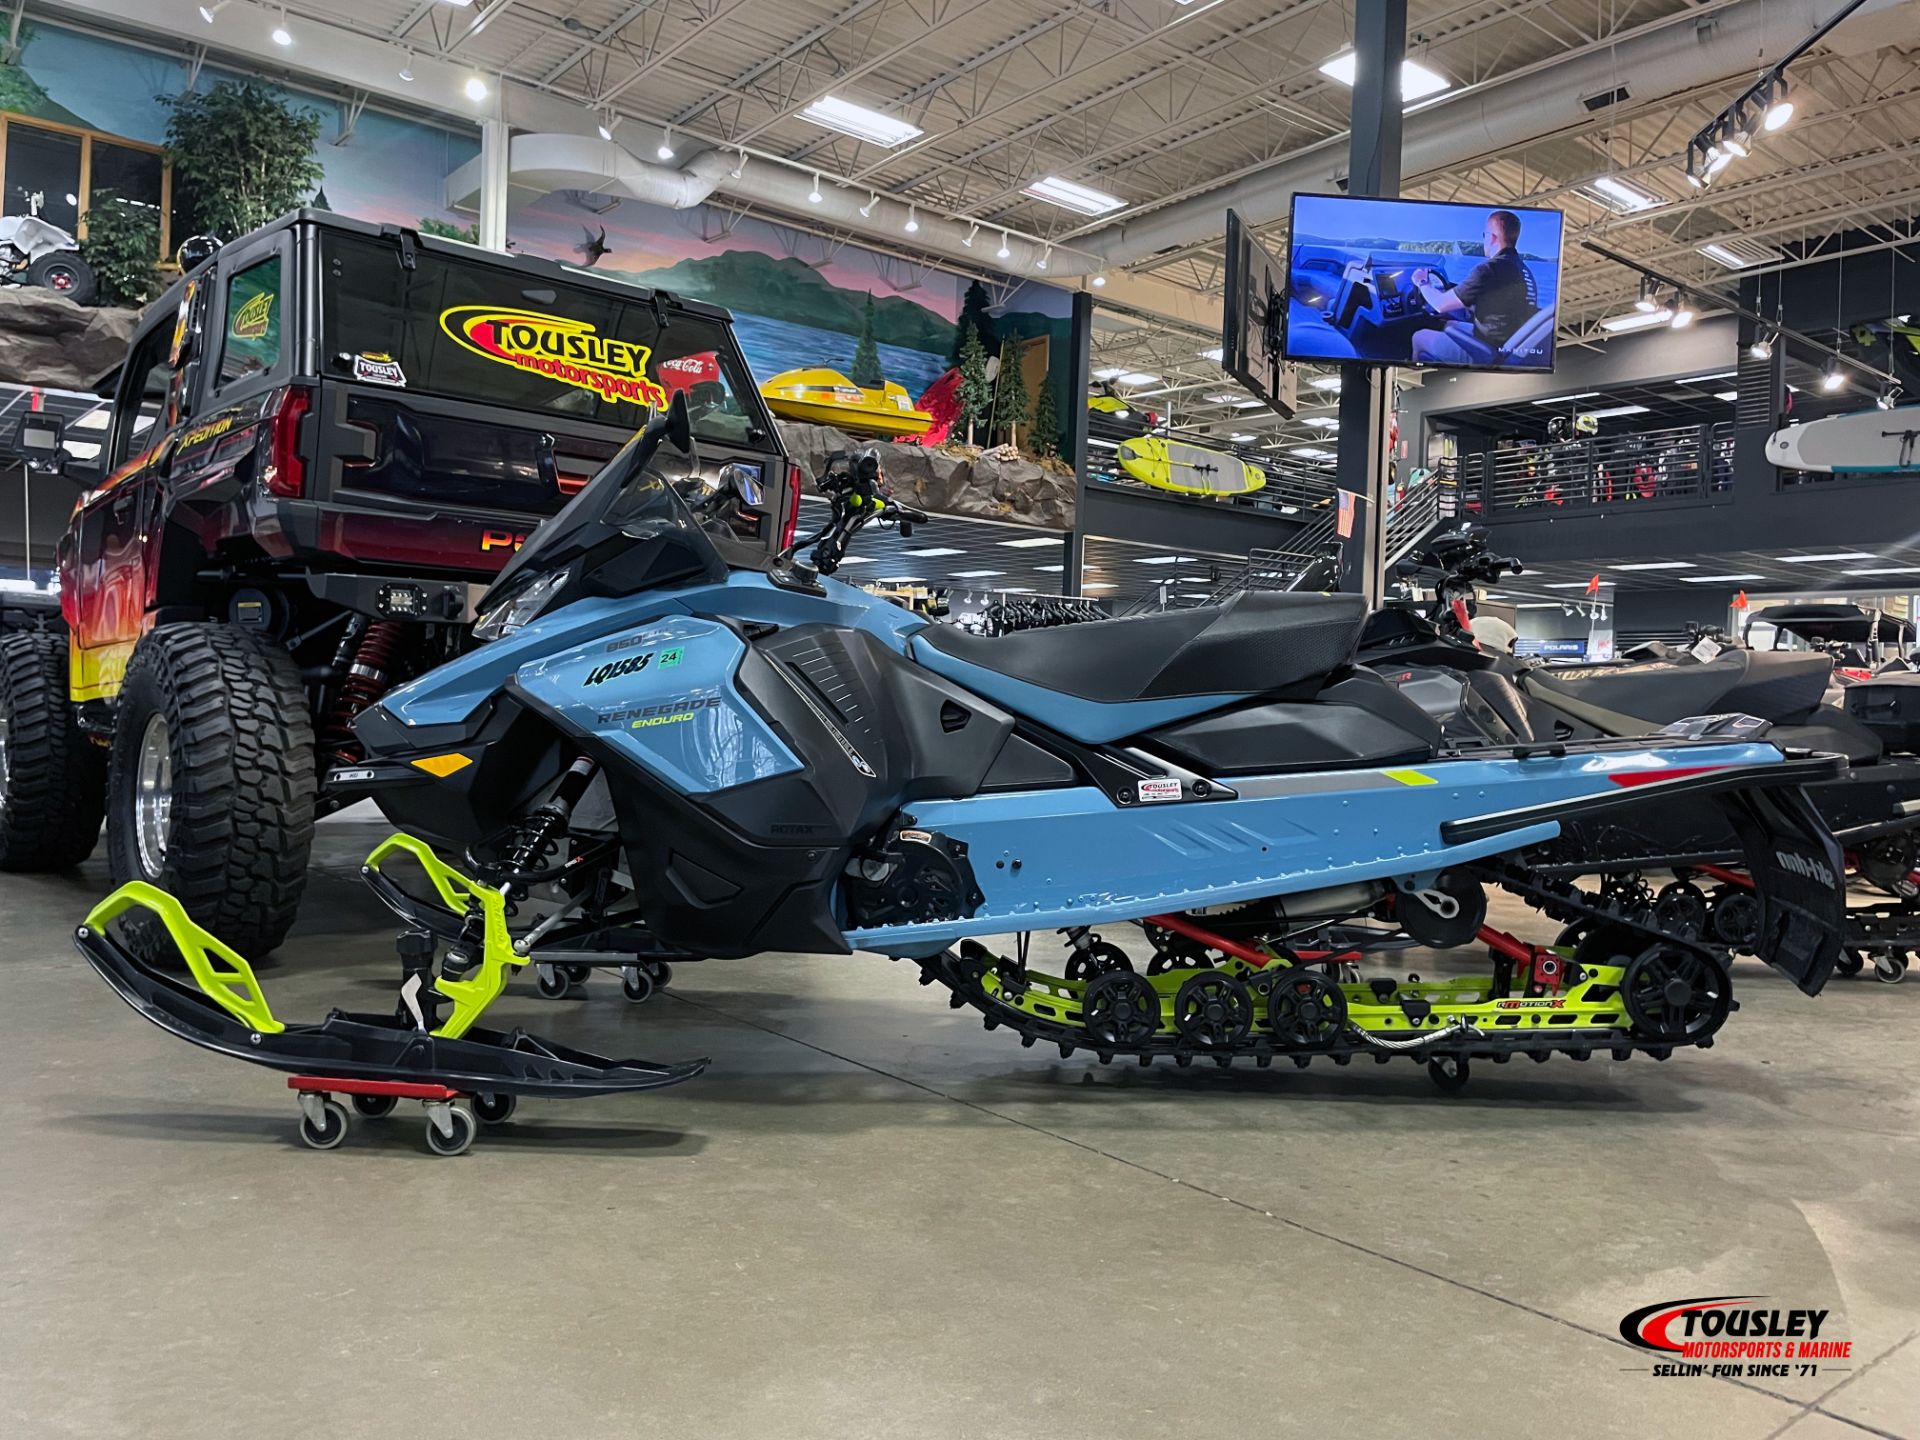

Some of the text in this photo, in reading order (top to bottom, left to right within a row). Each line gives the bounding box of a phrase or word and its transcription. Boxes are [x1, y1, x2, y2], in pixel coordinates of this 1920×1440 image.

[486, 319, 649, 373] TOUSLEY
[360, 361, 398, 378] TOUSLEY
[516, 352, 662, 407] motorsports
[661, 652, 677, 663] 24
[597, 696, 722, 724] RENEGADE
[631, 712, 695, 729] ENDURO
